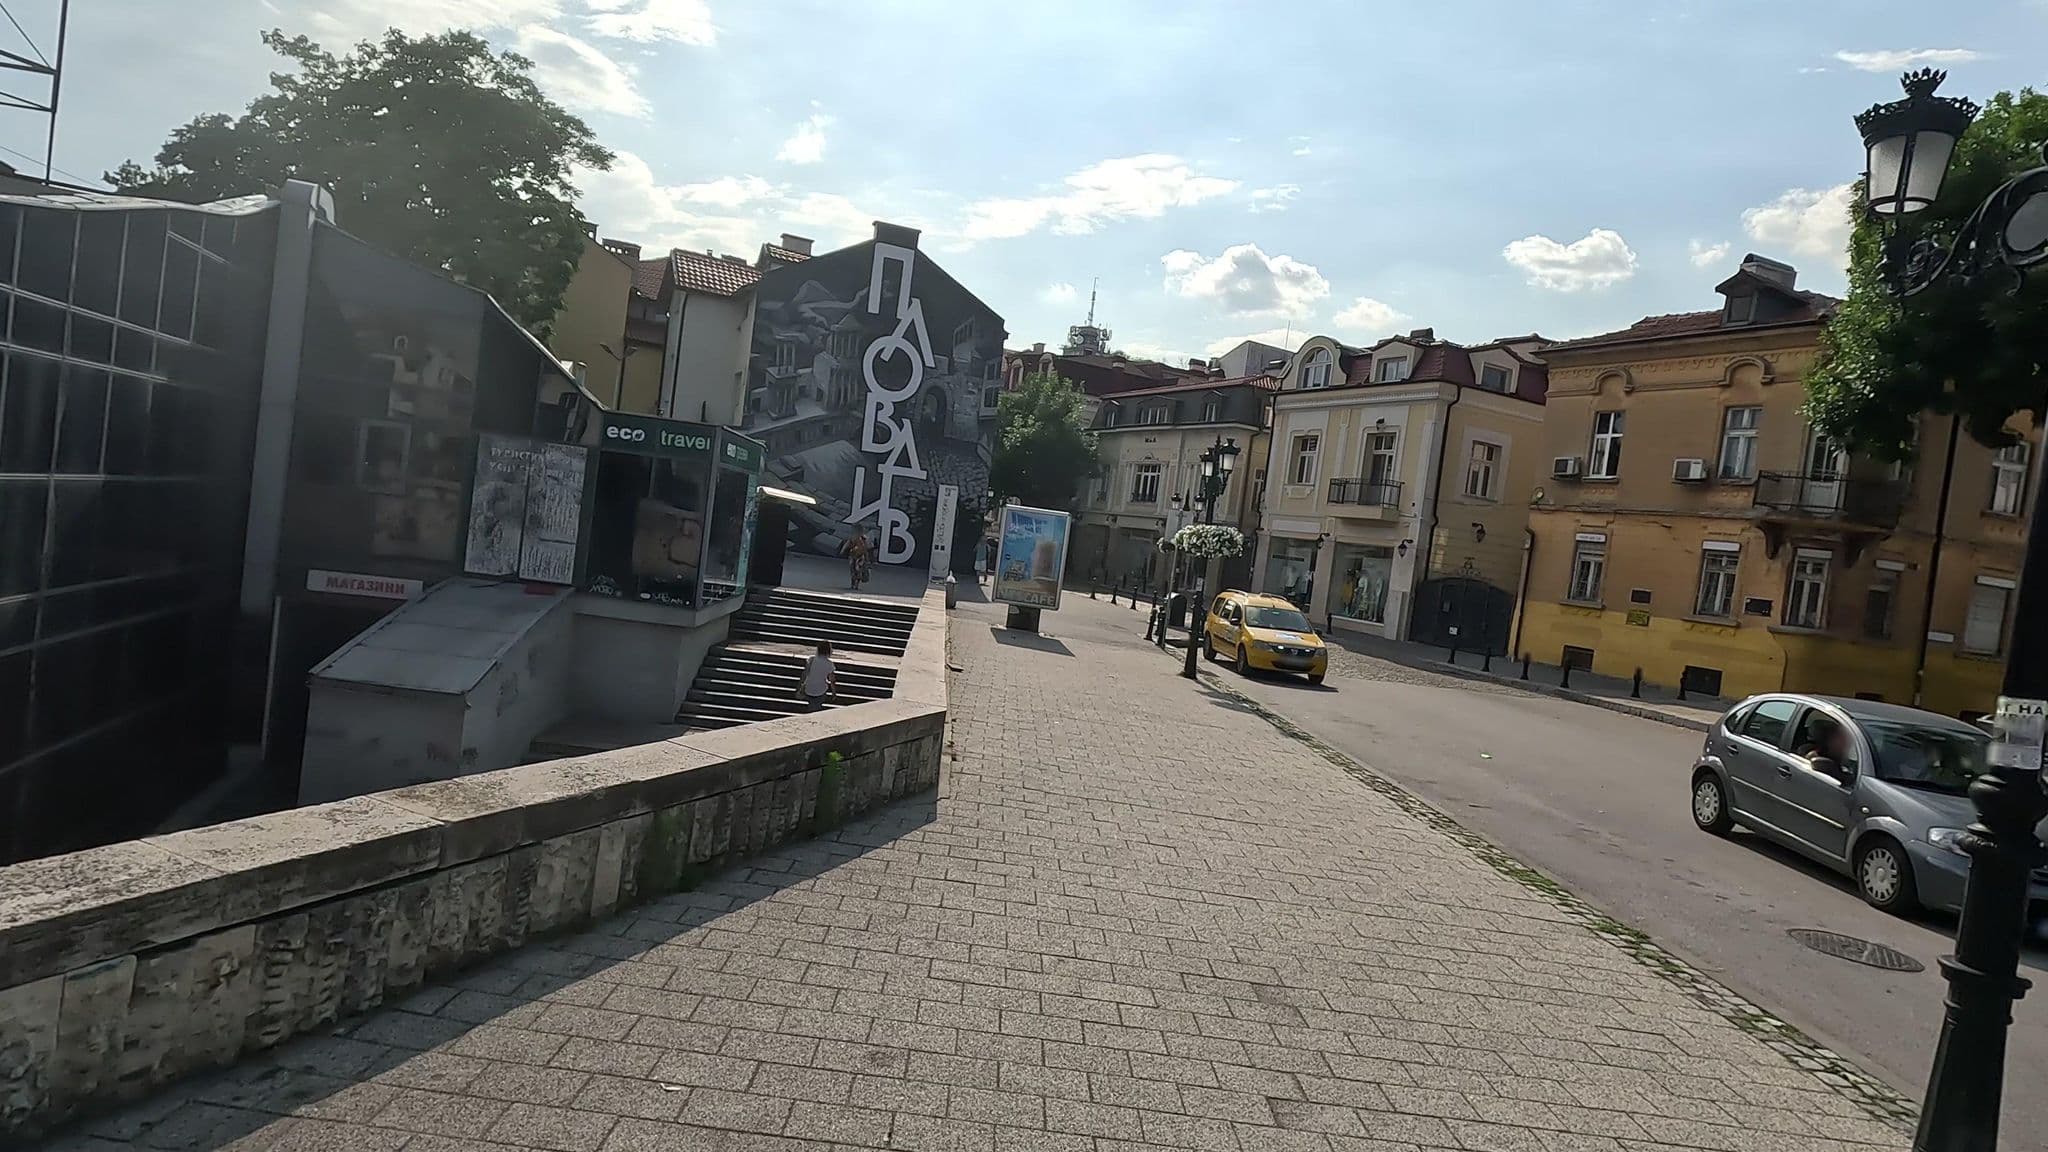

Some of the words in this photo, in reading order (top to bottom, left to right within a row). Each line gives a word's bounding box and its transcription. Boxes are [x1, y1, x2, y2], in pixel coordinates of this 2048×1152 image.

[841, 242, 936, 564] ПЛОВДИВ
[606, 425, 646, 442] eco
[660, 430, 711, 450] travel
[326, 576, 405, 594] МАГАЗИНИ
